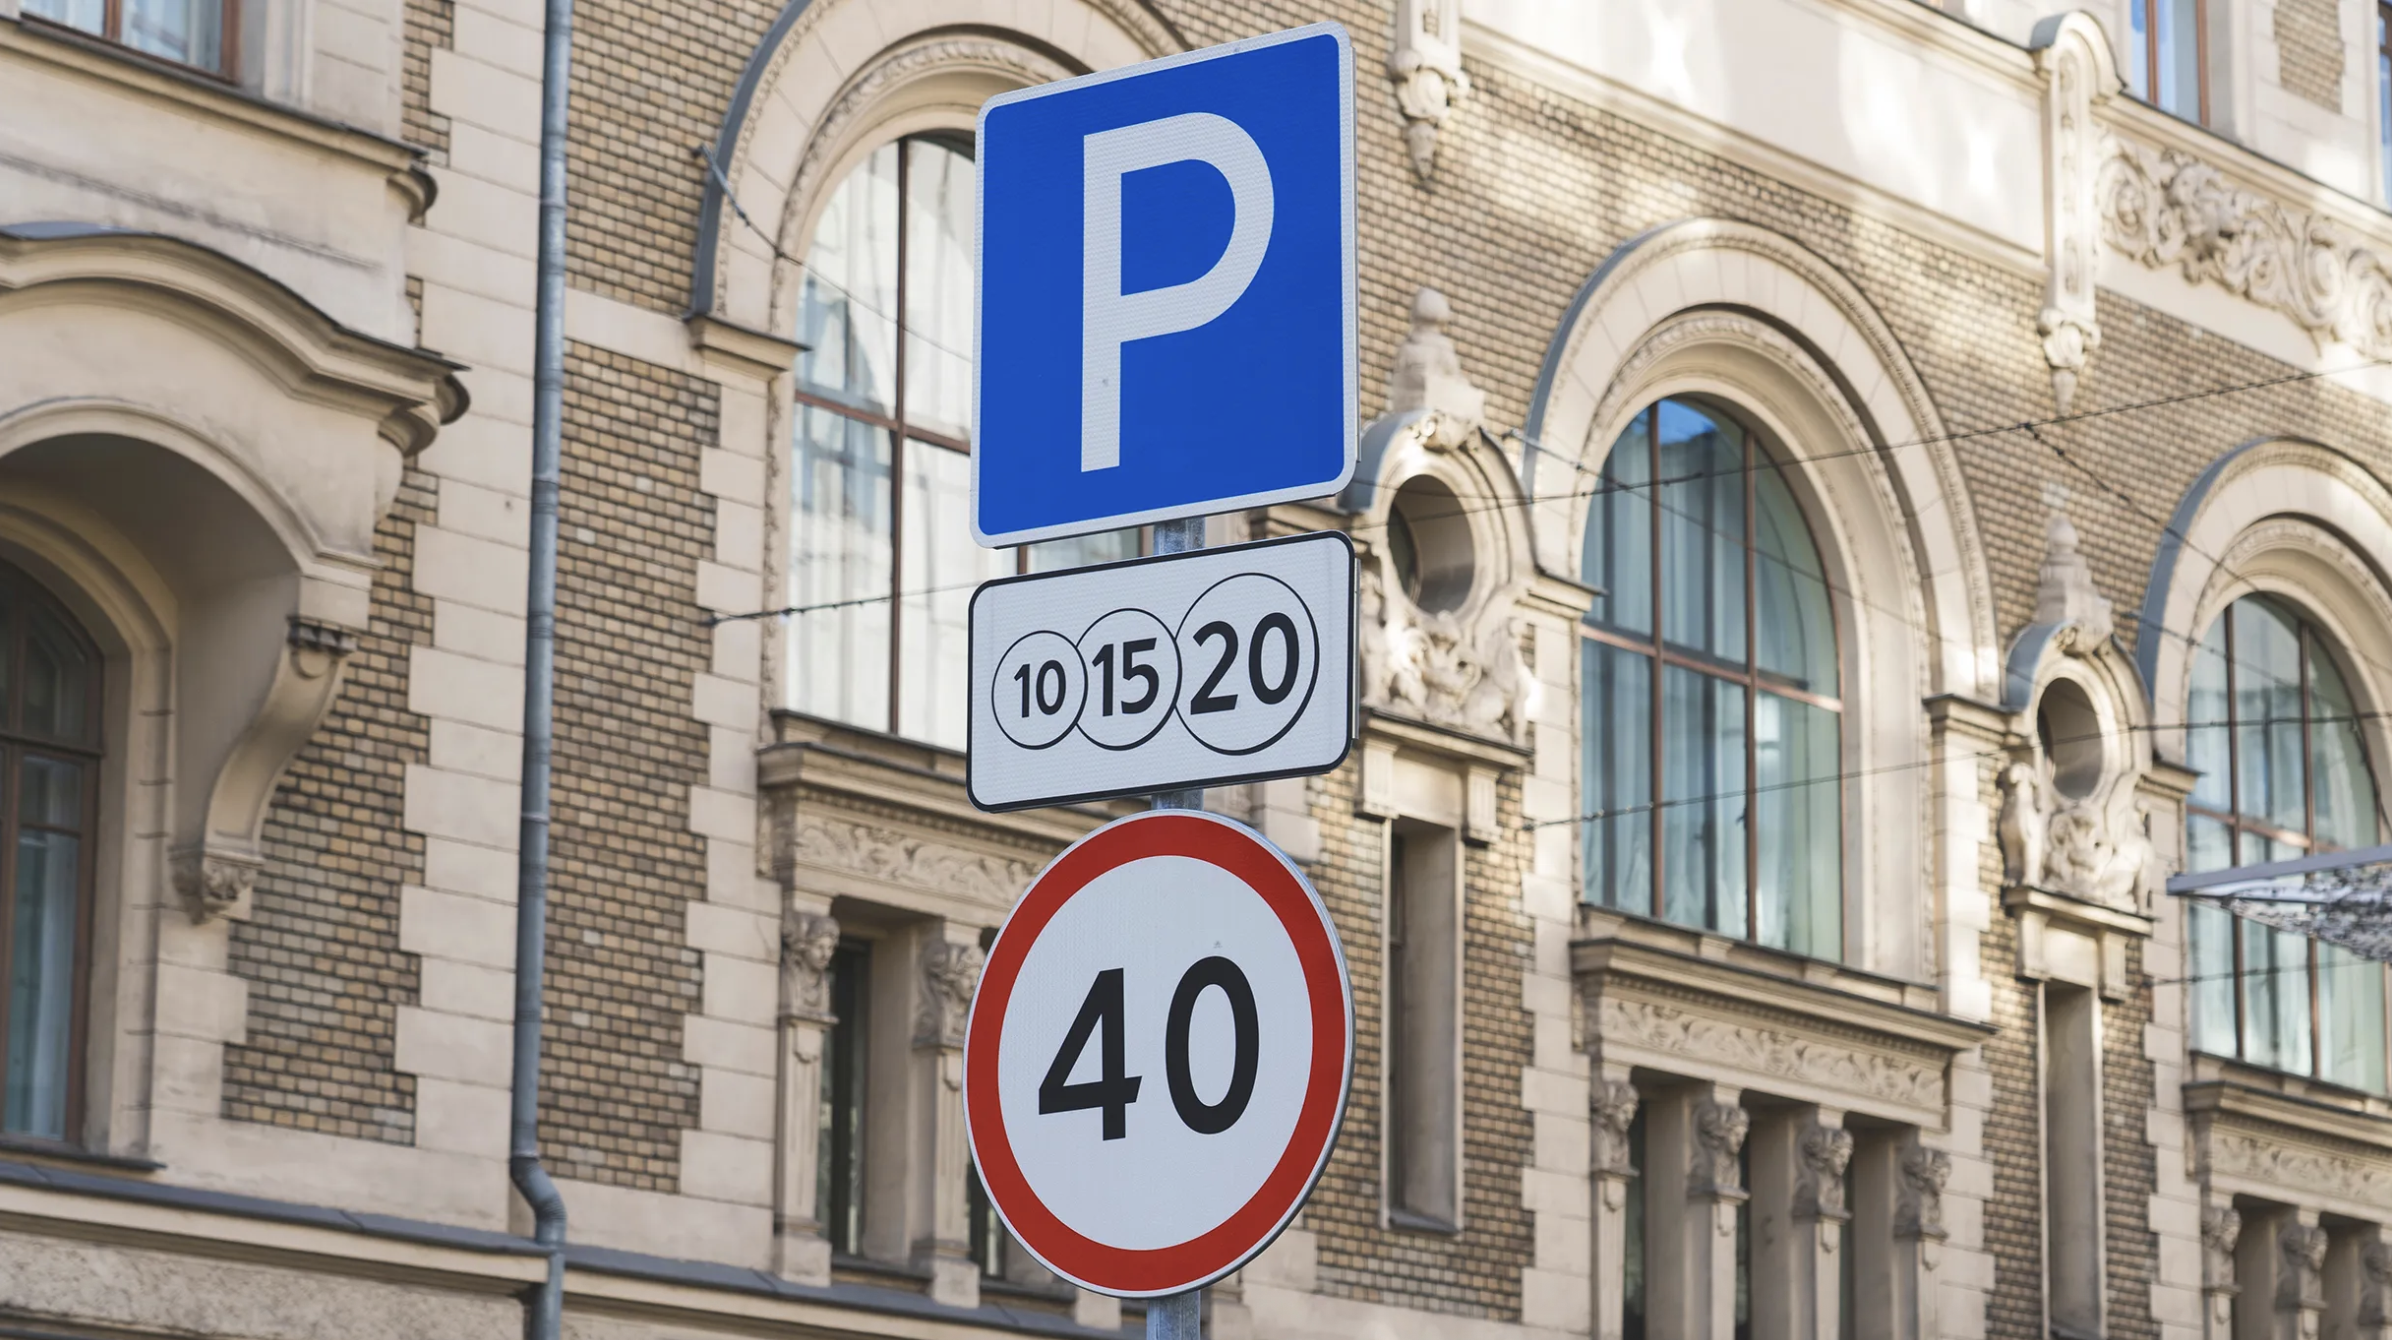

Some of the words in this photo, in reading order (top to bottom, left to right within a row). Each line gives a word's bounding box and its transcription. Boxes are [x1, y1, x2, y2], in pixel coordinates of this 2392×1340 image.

[1081, 112, 1274, 473] P
[1013, 659, 1067, 719] 10
[1091, 637, 1160, 717] 15
[1190, 612, 1300, 716] 20
[1038, 955, 1260, 1141] 40
